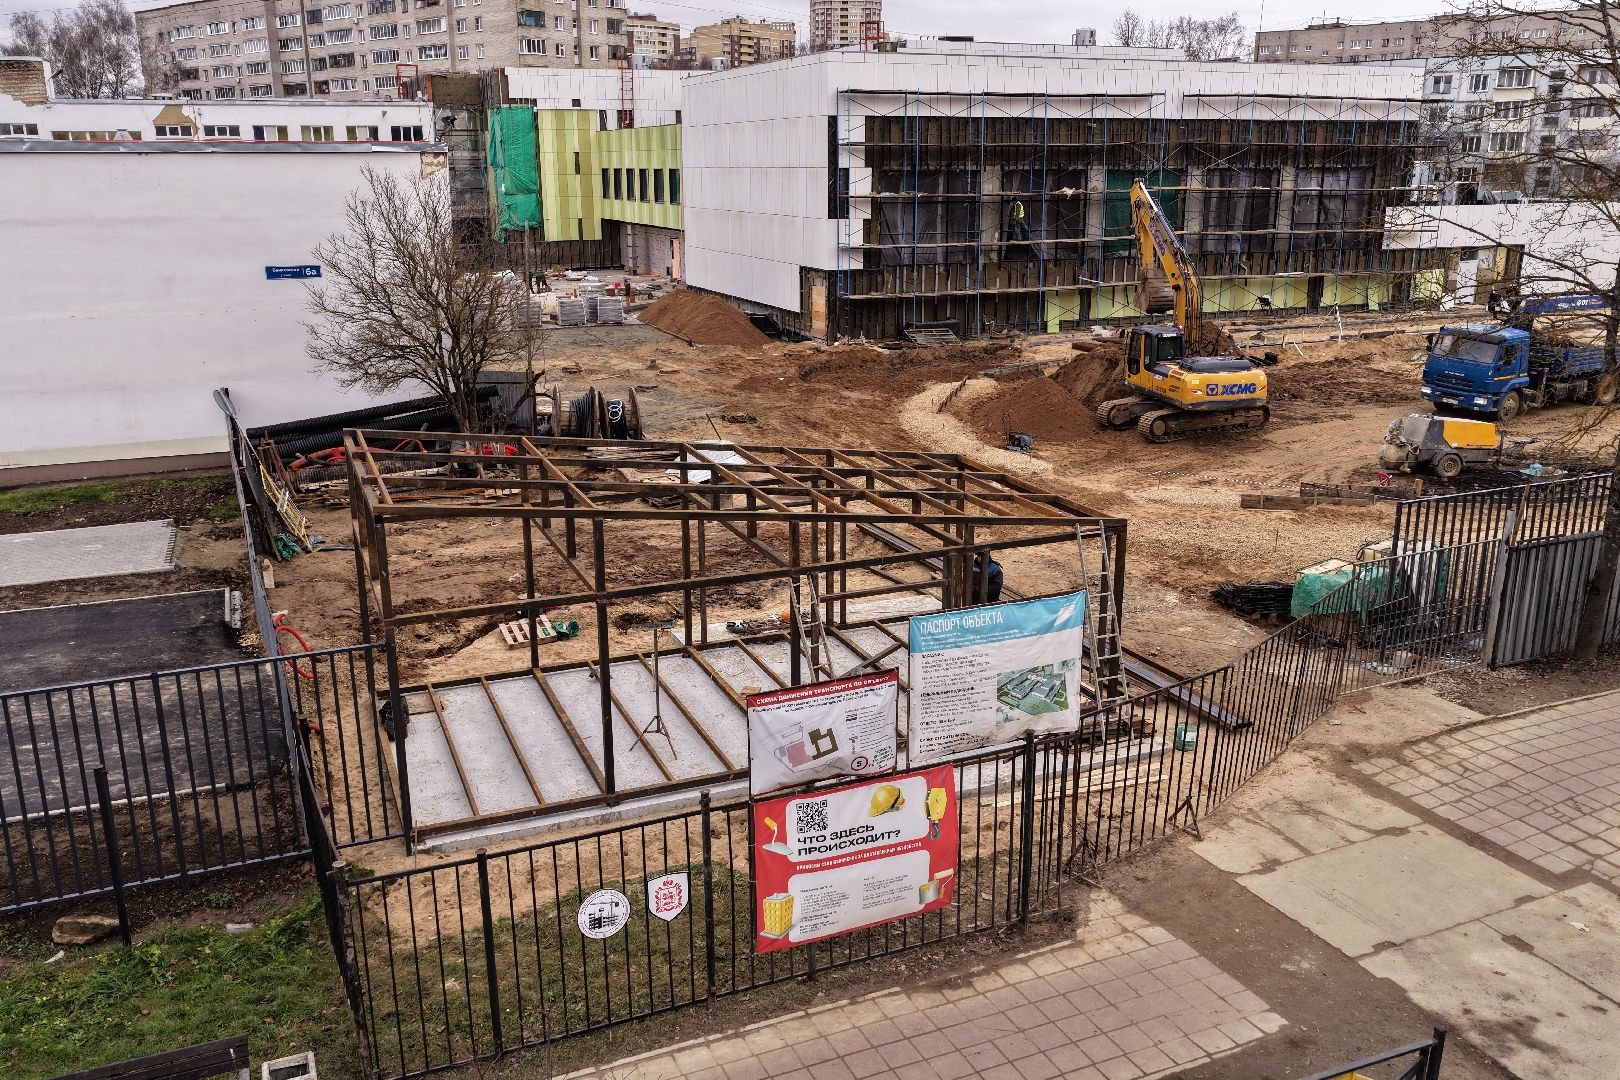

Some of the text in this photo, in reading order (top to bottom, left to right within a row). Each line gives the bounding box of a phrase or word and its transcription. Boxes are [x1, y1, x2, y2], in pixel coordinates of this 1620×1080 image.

[1218, 382, 1257, 396] XCMG
[920, 612, 1003, 634] ПАСПОРТ ОБЪЕКТА
[778, 690, 813, 702] ДВИЖЕНИЯ
[813, 683, 853, 694] ТРАНСПОРТА
[853, 680, 862, 688] ПО
[856, 760, 863, 768] 5
[797, 824, 875, 846] ЧТО ЗДЕСЬ
[797, 829, 901, 857] ПРОИСХОДИТ?
